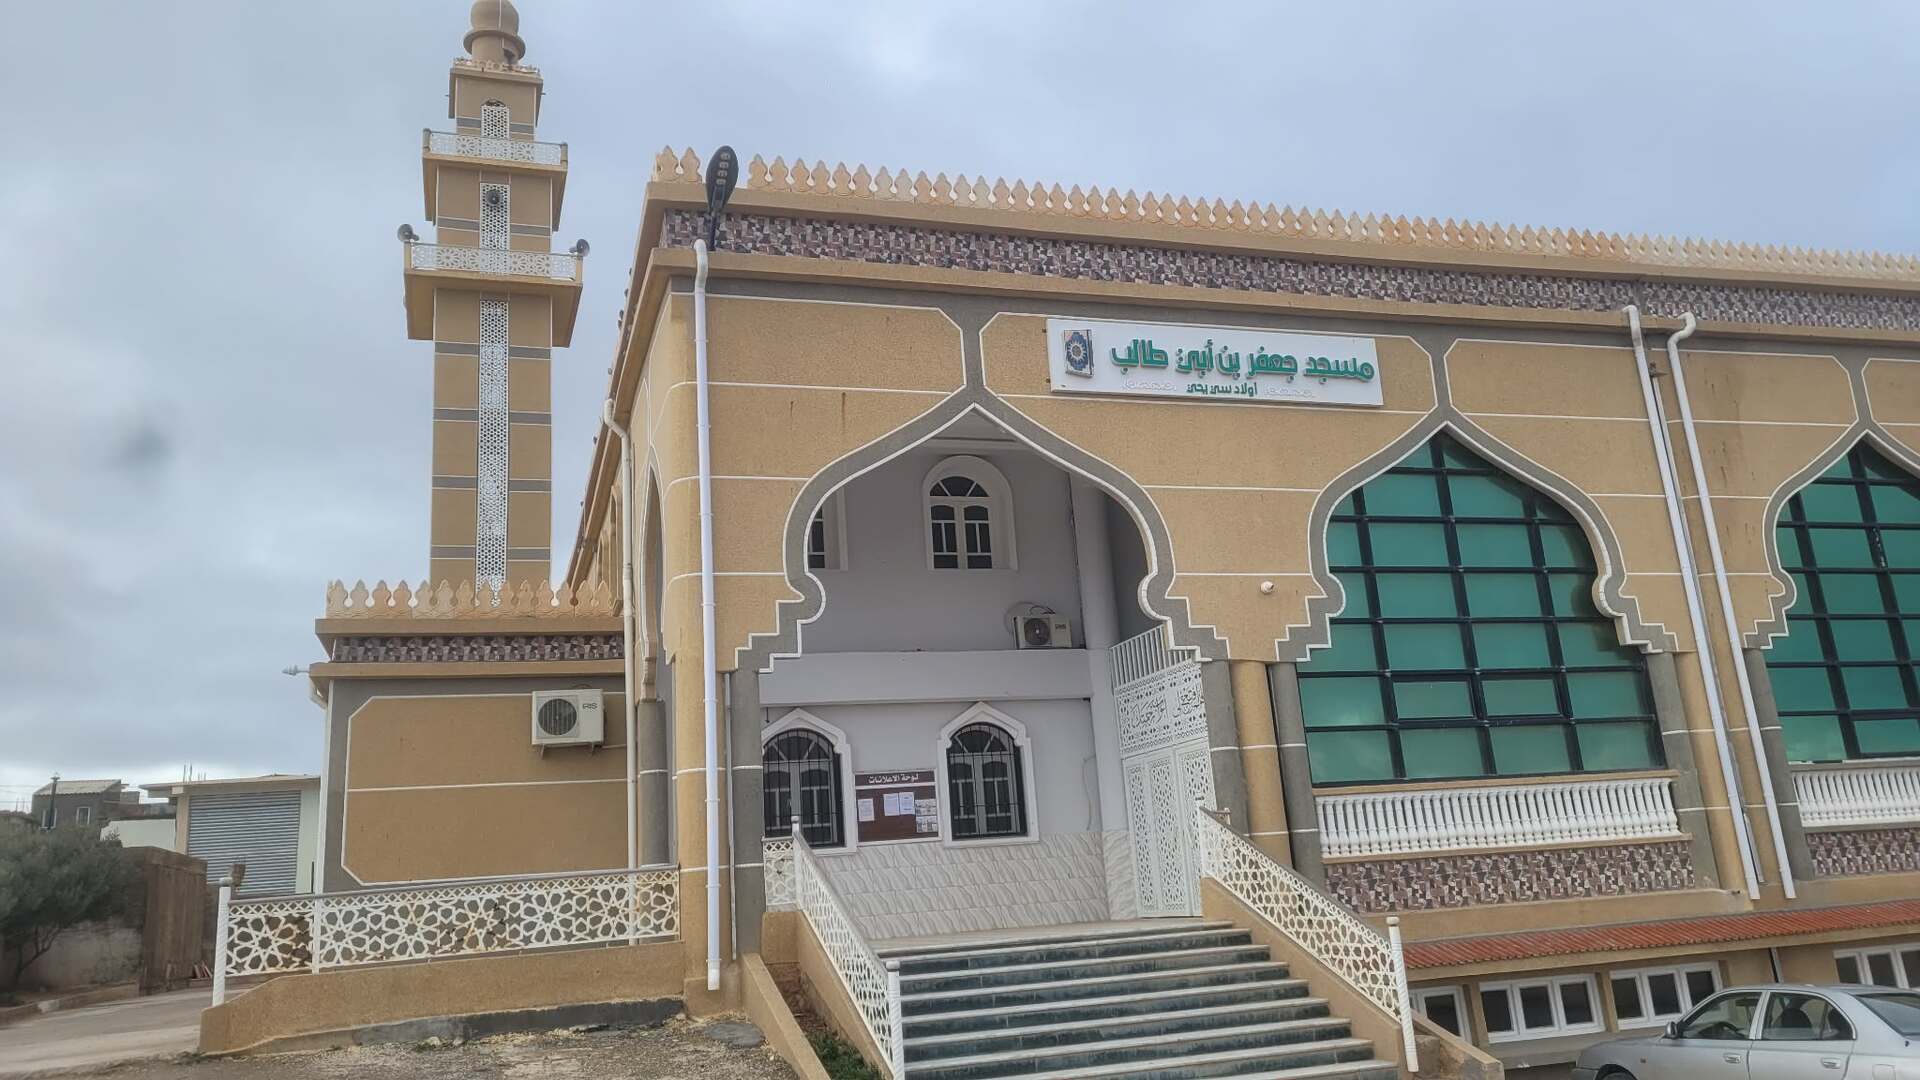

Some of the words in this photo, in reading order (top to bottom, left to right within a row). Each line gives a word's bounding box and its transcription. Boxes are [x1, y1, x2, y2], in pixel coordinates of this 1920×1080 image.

[1110, 339, 1169, 374] طالب
[1176, 339, 1214, 378] أبي
[1216, 346, 1241, 379] بن
[1247, 346, 1298, 383] جعفر
[1303, 356, 1375, 384] مسجد
[1209, 384, 1232, 395] سي
[901, 773, 919, 783] لوحة
